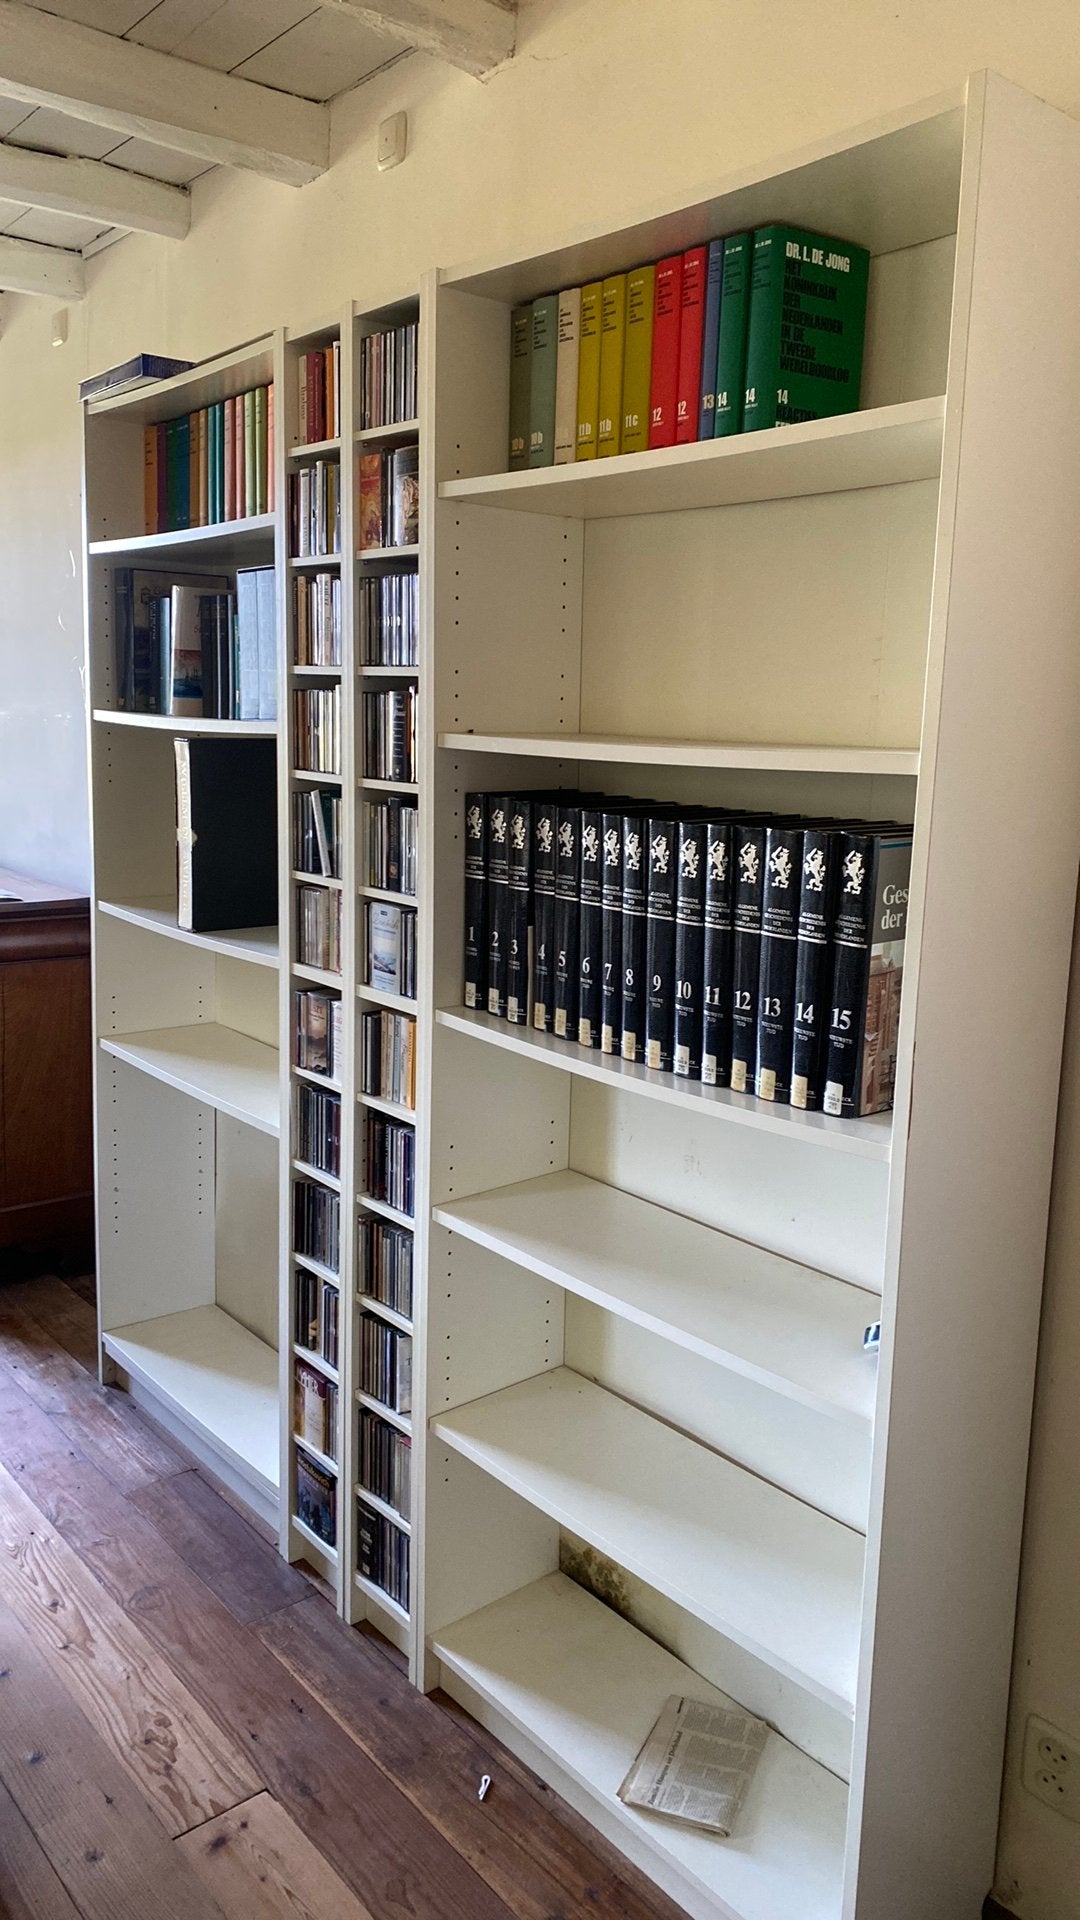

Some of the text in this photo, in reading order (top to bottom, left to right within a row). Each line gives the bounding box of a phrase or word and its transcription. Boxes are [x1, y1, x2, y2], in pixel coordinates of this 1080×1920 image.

[786, 241, 801, 260] DR.
[803, 246, 810, 262] L.
[812, 248, 824, 266] DE
[826, 253, 850, 272] JONG
[703, 394, 714, 409] 13
[718, 392, 728, 407] 14
[745, 388, 756, 404] 14
[776, 389, 788, 405] 14
[652, 407, 662, 422] 12
[678, 401, 686, 415] 12
[881, 909, 904, 930] der
[468, 926, 475, 942] 1
[492, 931, 499, 947] 2
[510, 939, 518, 955] 3
[538, 944, 546, 960] 4
[558, 951, 566, 967] 5
[582, 956, 590, 974] 6
[604, 963, 612, 980] 7
[626, 968, 634, 986] 8
[653, 974, 661, 992] 9
[676, 980, 692, 999] 10
[705, 986, 721, 1006] 11
[735, 990, 751, 1010] 12
[763, 997, 781, 1017] 13
[796, 1002, 814, 1024] 14
[832, 1008, 852, 1030] 15
